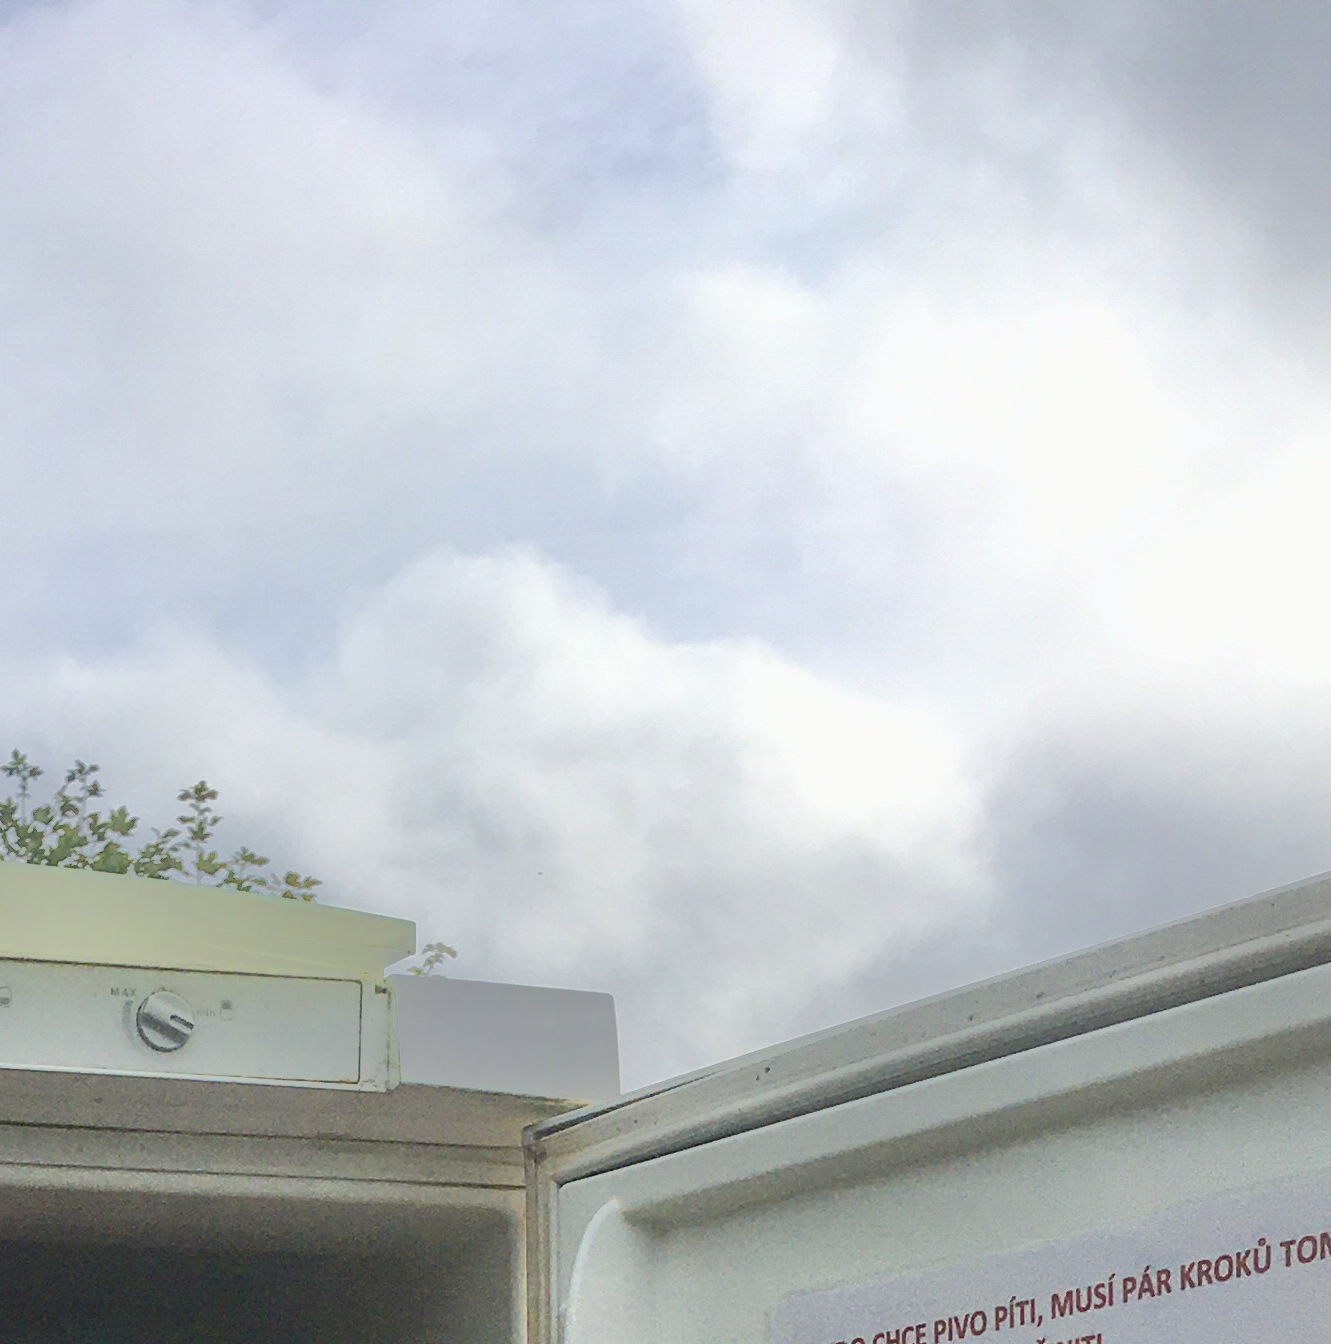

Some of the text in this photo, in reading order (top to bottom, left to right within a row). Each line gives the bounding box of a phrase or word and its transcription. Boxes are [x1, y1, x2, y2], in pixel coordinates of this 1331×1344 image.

[933, 1310, 987, 1344] PIVO
[994, 1296, 1043, 1331] PÍTI,
[1050, 1273, 1116, 1319] MUSÍ
[1122, 1264, 1172, 1303] PÁR
[1179, 1237, 1271, 1291] KROKŮ
